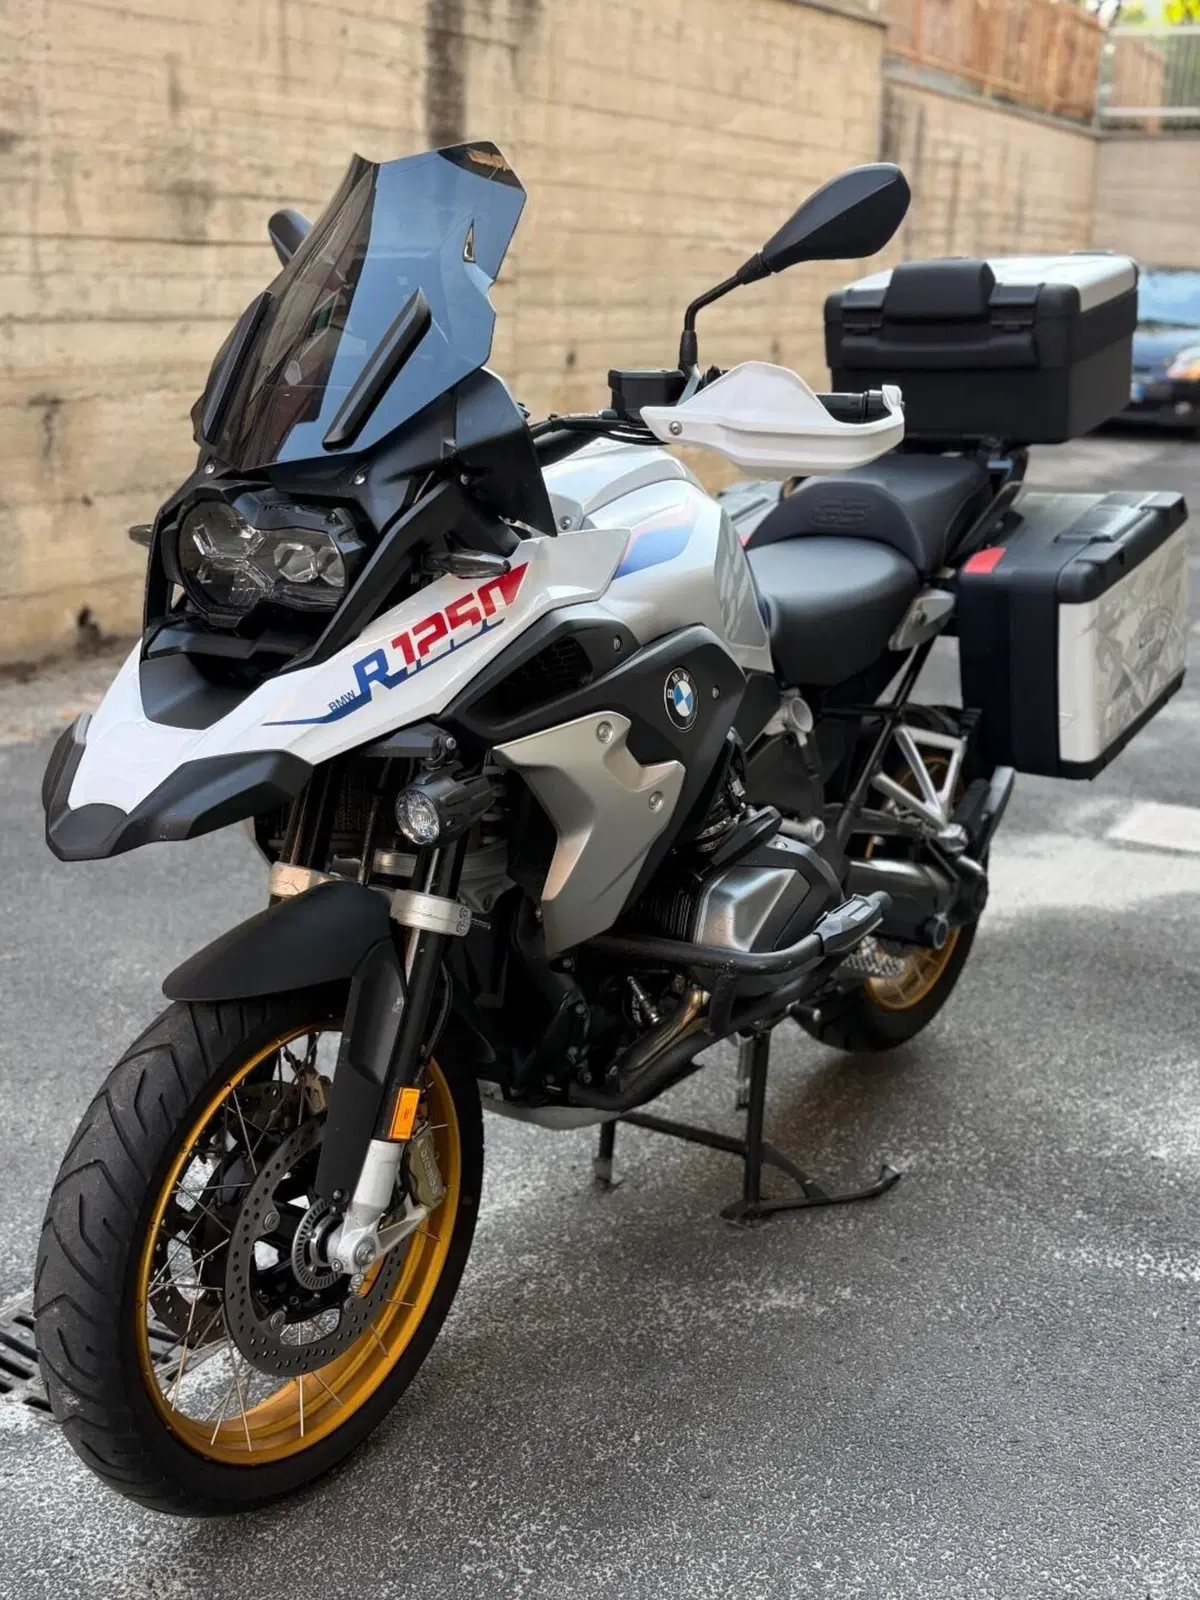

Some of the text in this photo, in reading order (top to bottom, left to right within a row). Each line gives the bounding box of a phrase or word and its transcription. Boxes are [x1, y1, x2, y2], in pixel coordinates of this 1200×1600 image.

[328, 562, 528, 713] BMW R 1250
[667, 672, 690, 699] BMW
[420, 1147, 439, 1195] brembo
